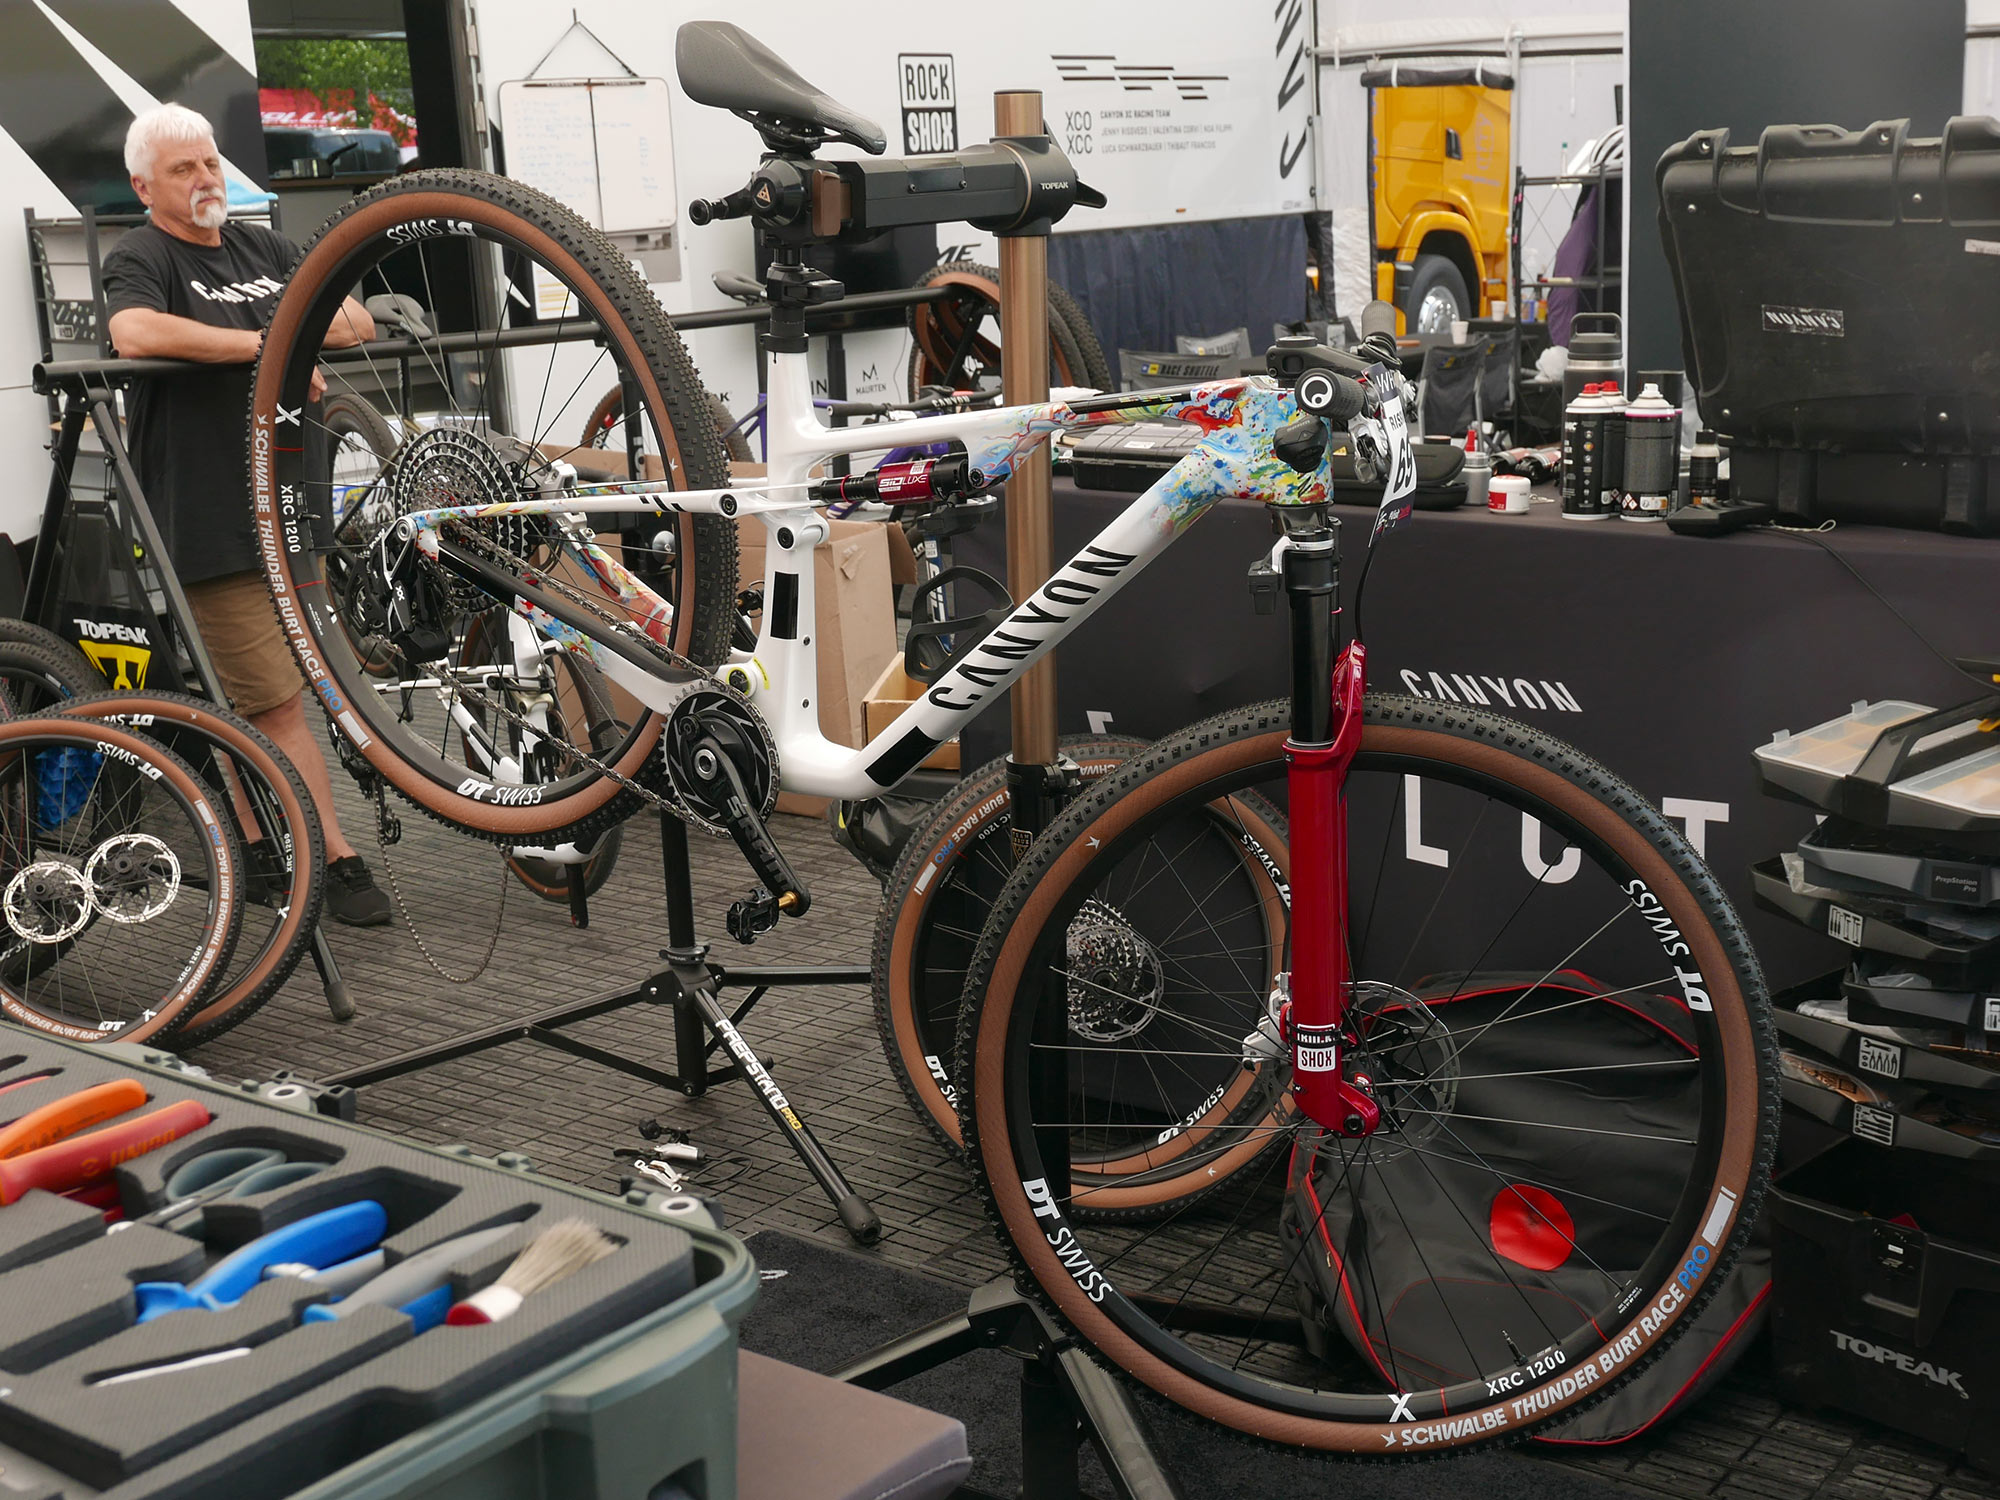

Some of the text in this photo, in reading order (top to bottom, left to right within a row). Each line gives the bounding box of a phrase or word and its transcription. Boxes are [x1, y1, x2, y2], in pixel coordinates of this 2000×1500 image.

[905, 63, 949, 101] ROCK
[907, 111, 954, 153] SHOX
[1065, 111, 1092, 131] XCO
[1156, 109, 1170, 117] TEAM
[1067, 134, 1092, 154] XCC
[1040, 181, 1069, 190] TOPEAK
[387, 219, 477, 245] DT SWISS
[1766, 311, 1842, 329] CANYON
[1160, 364, 1220, 376] RACE SHUTTLE
[856, 384, 886, 395] MAURTEN
[932, 396, 970, 407] CANYON
[254, 428, 271, 513] SCHWALBE
[281, 484, 301, 553] XRC 1200
[259, 519, 286, 593] THUNDER
[73, 618, 150, 646] TOPEAK
[277, 597, 304, 635] BURT
[928, 546, 1138, 711] CANYON
[294, 637, 326, 679] RACE
[317, 679, 343, 711] PRO
[1400, 668, 1583, 713] CANYON
[129, 714, 155, 726] DT
[96, 741, 164, 781] DT SWISS
[457, 777, 547, 805] DT SWISS
[934, 793, 1005, 864] BURT RACE PRO
[978, 822, 1000, 840] 1200
[1935, 875, 1978, 886] PrepStation
[1963, 885, 1977, 893] Pro
[182, 825, 230, 1000] PRO RACE BURT THUNDER SCHWALBE
[177, 945, 203, 983] XRC 1200
[1620, 879, 1713, 1011] DT SWISS
[8, 1002, 108, 1041] THUNDER BURT RAC
[715, 1019, 803, 1130] PREPSTAND PRO
[924, 1054, 947, 1081] DT
[1301, 1050, 1332, 1068] SHOX
[1157, 1084, 1225, 1145] DT SWISS
[1022, 1177, 1114, 1303] DT SWISS
[1402, 1408, 1508, 1447] SCHWALBE
[1511, 1363, 1600, 1420] THUNDER
[1599, 1327, 1644, 1374] BURT
[1639, 1282, 1686, 1337] RACE
[1678, 1245, 1710, 1290] PRO
[1829, 1329, 1970, 1399] TOPEAK
[1485, 1350, 1567, 1397] XRC 1200
